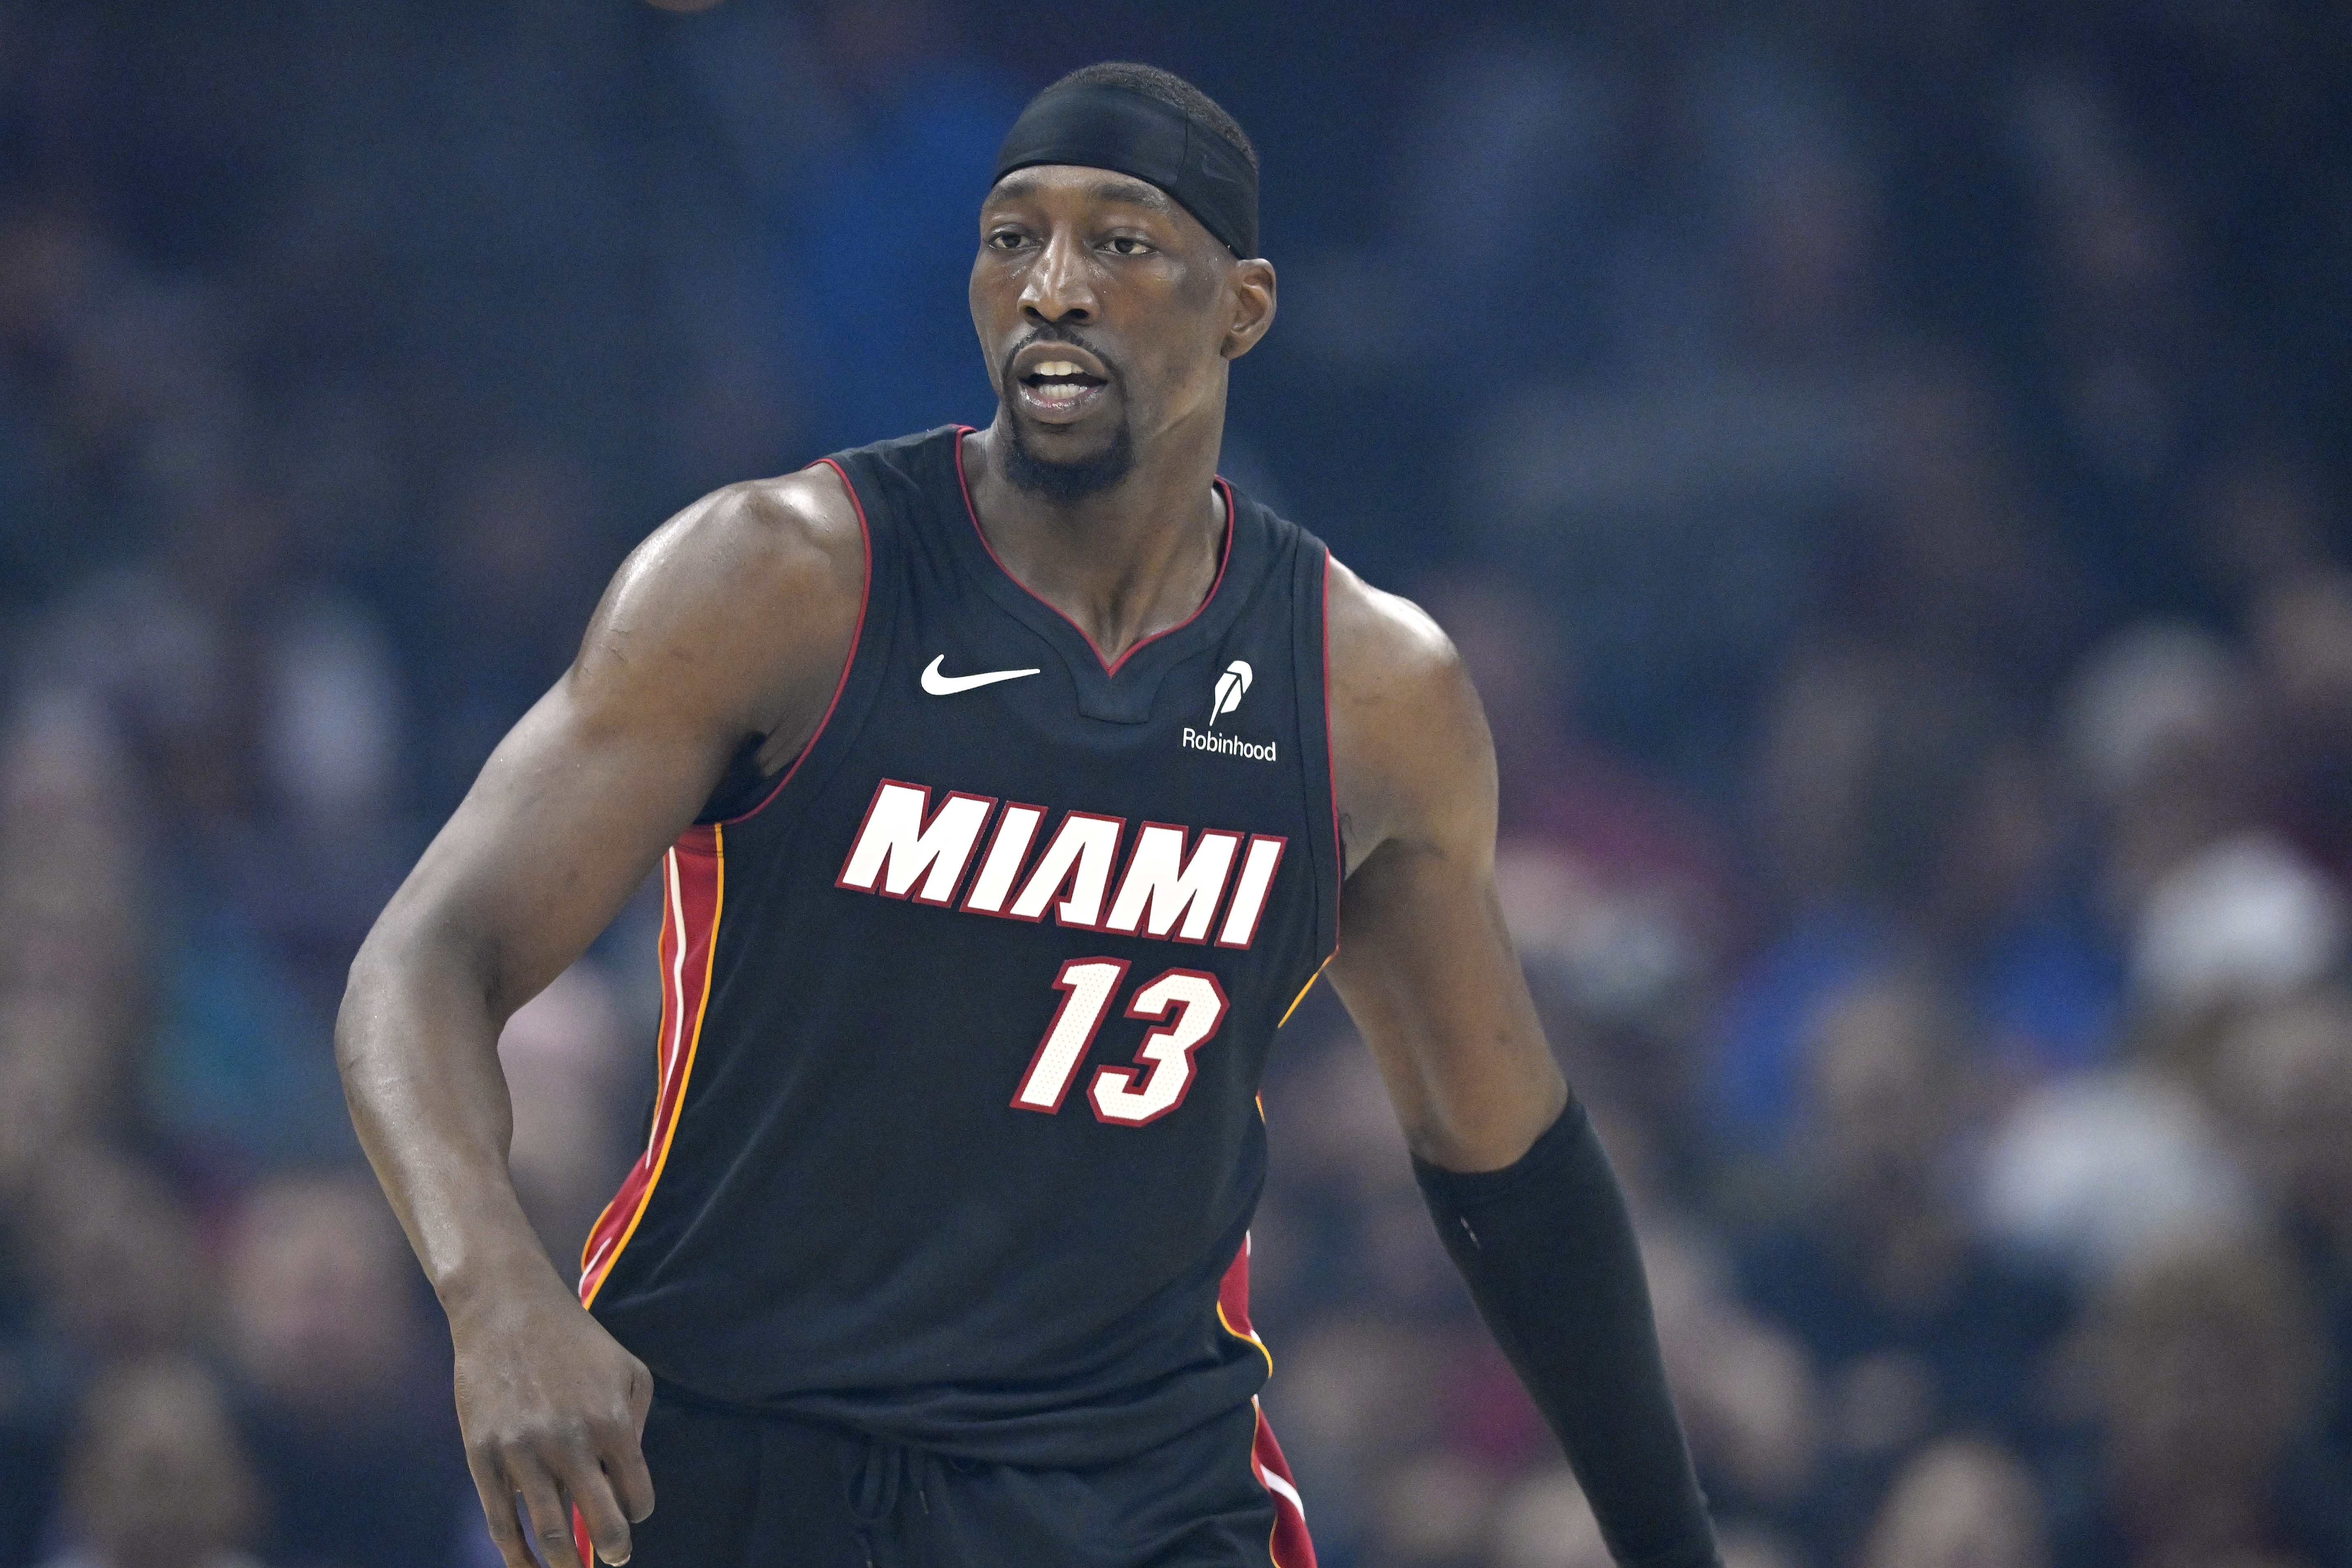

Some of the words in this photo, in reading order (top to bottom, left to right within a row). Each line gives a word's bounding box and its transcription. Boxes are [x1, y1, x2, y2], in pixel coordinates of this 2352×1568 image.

[1182, 728, 1276, 761] Robinhood
[836, 778, 1288, 949] MIAMI
[1010, 956, 1230, 1127] 13
